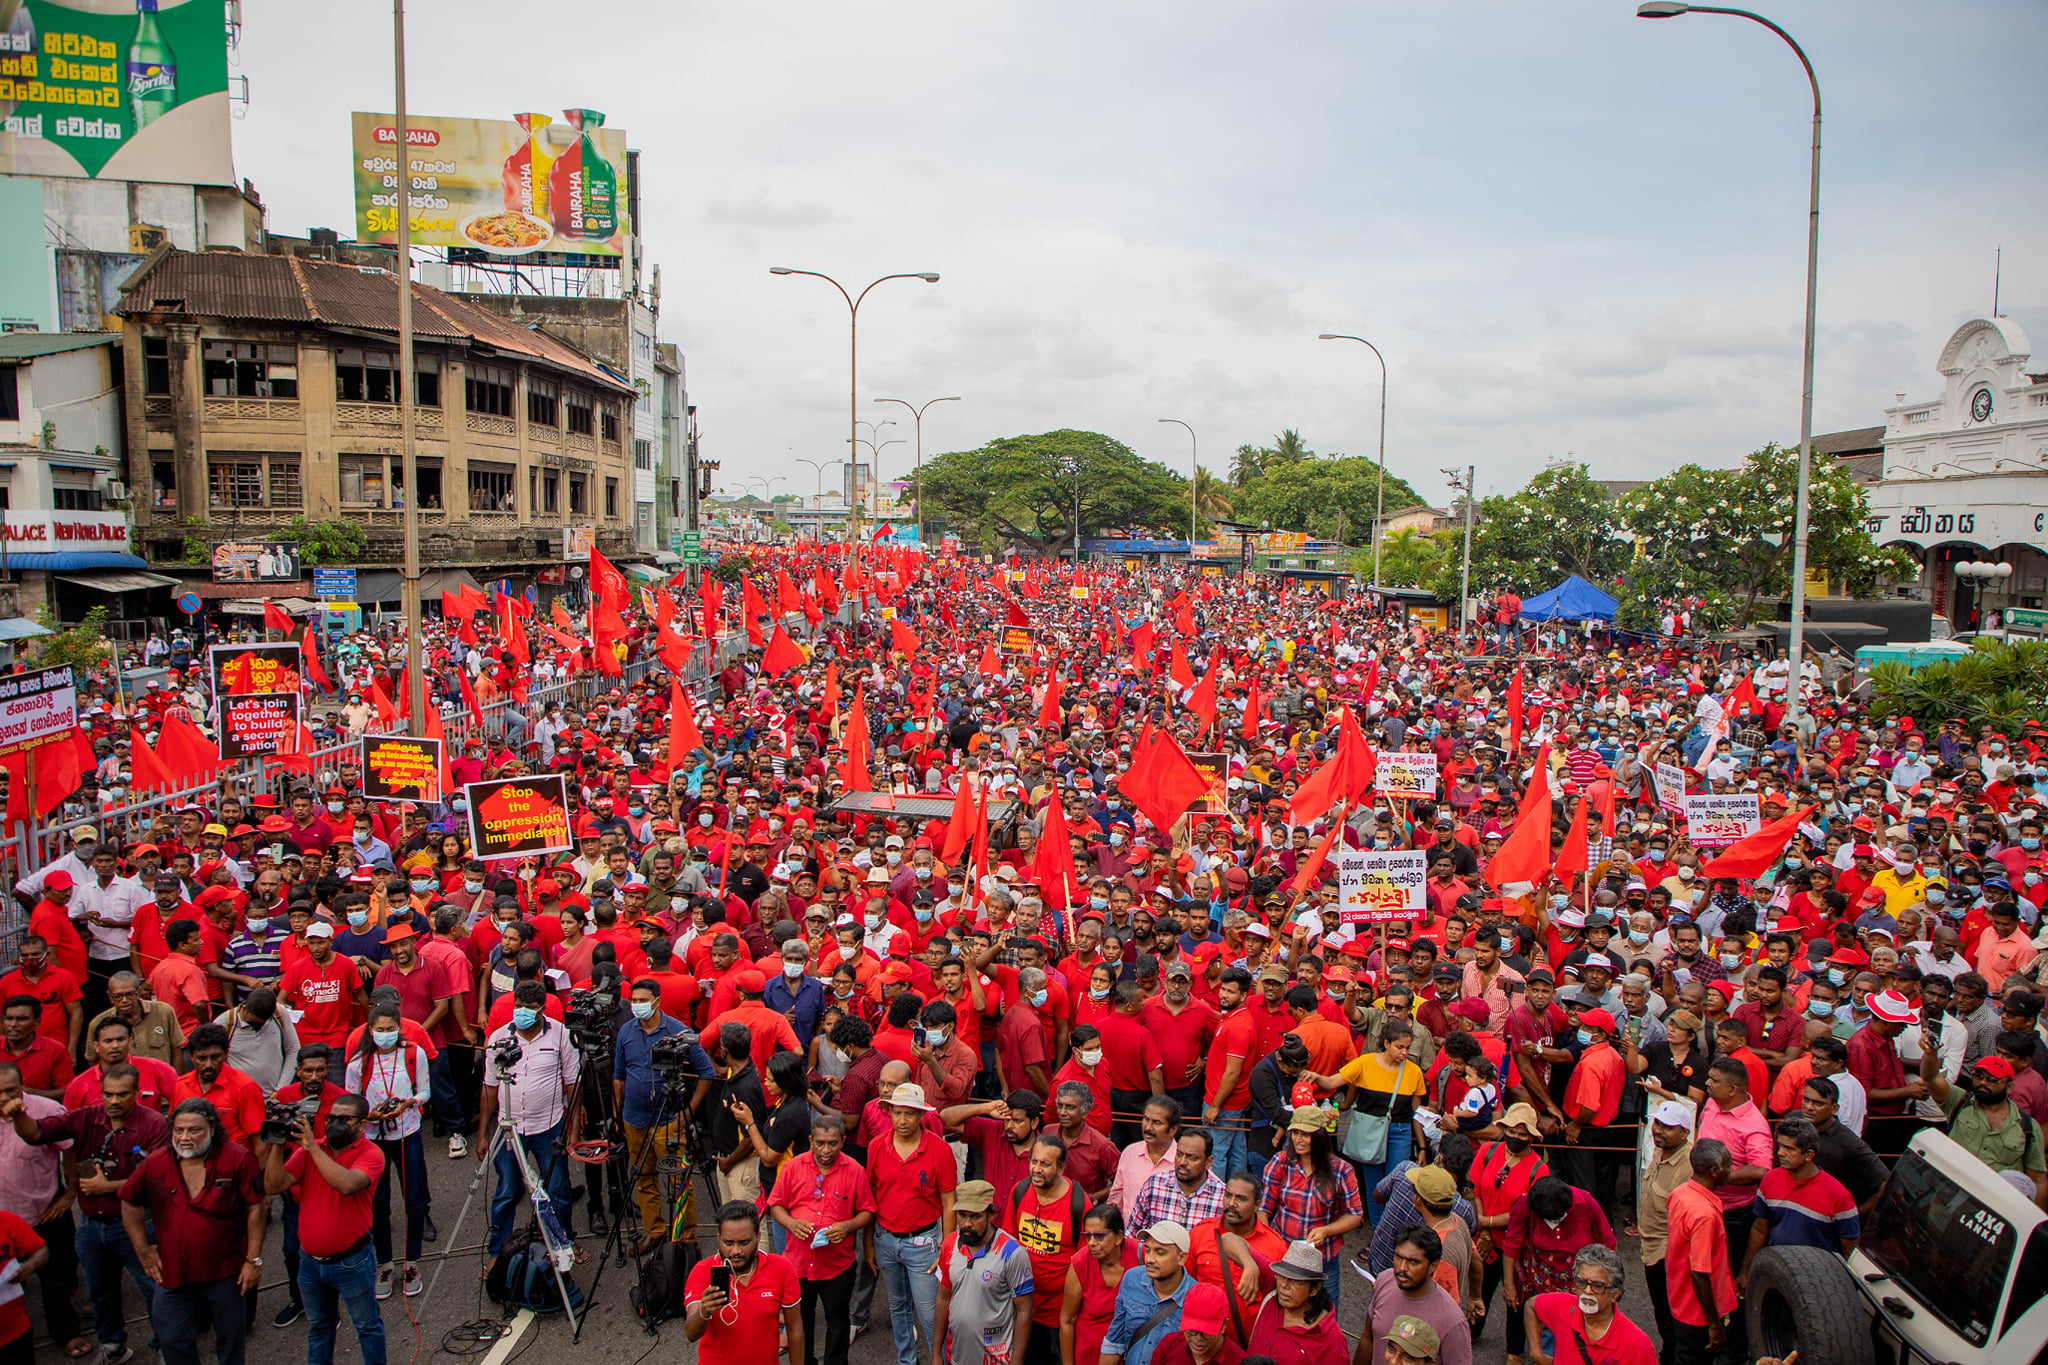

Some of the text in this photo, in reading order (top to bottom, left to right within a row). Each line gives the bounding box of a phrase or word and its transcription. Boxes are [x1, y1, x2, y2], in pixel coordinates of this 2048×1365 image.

[133, 72, 170, 92] Sprite
[56, 117, 121, 139] වෙන්න
[570, 171, 583, 228] BAIRAHA
[53, 521, 126, 541] NEW HOTEL PALACE
[1002, 642, 1031, 652] democracy
[229, 699, 287, 710] Let's join
[231, 710, 286, 722] together
[234, 719, 282, 731] to build
[243, 730, 285, 740] secure
[241, 741, 279, 751] nation
[1196, 763, 1215, 771] hase
[501, 788, 533, 799] Stop
[508, 802, 530, 812] the
[485, 813, 561, 831] oppression
[485, 825, 567, 844] immediately
[313, 980, 337, 989] WALK
[1959, 1214, 1998, 1245] LANKA
